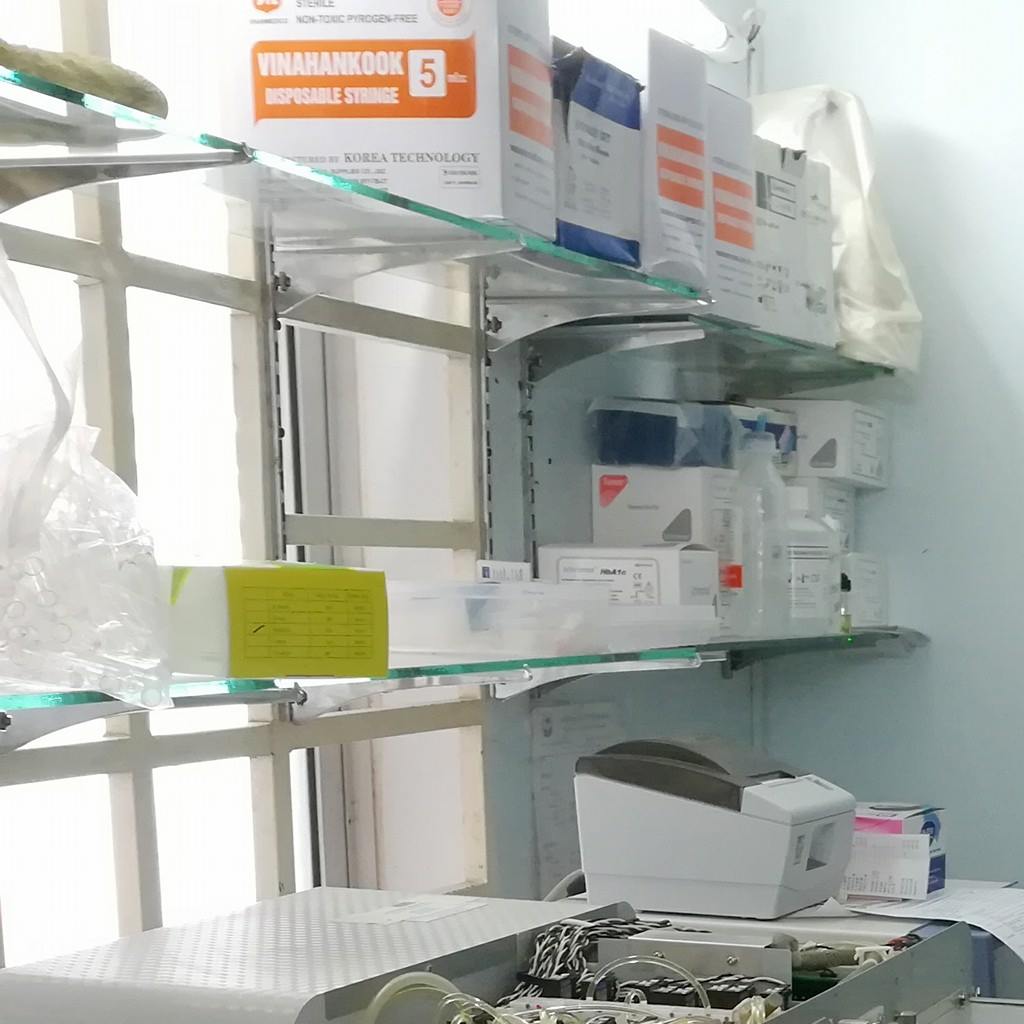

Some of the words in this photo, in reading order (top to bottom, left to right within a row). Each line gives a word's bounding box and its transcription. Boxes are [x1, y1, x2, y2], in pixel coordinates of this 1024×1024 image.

[296, 15, 345, 24] NON-TOXIC
[347, 14, 418, 24] PYROGEN-FREE
[257, 51, 404, 77] VINAHANKOOK
[419, 58, 436, 88] 5
[344, 152, 389, 163] KOREA
[391, 152, 480, 164] TECHNOLOGY
